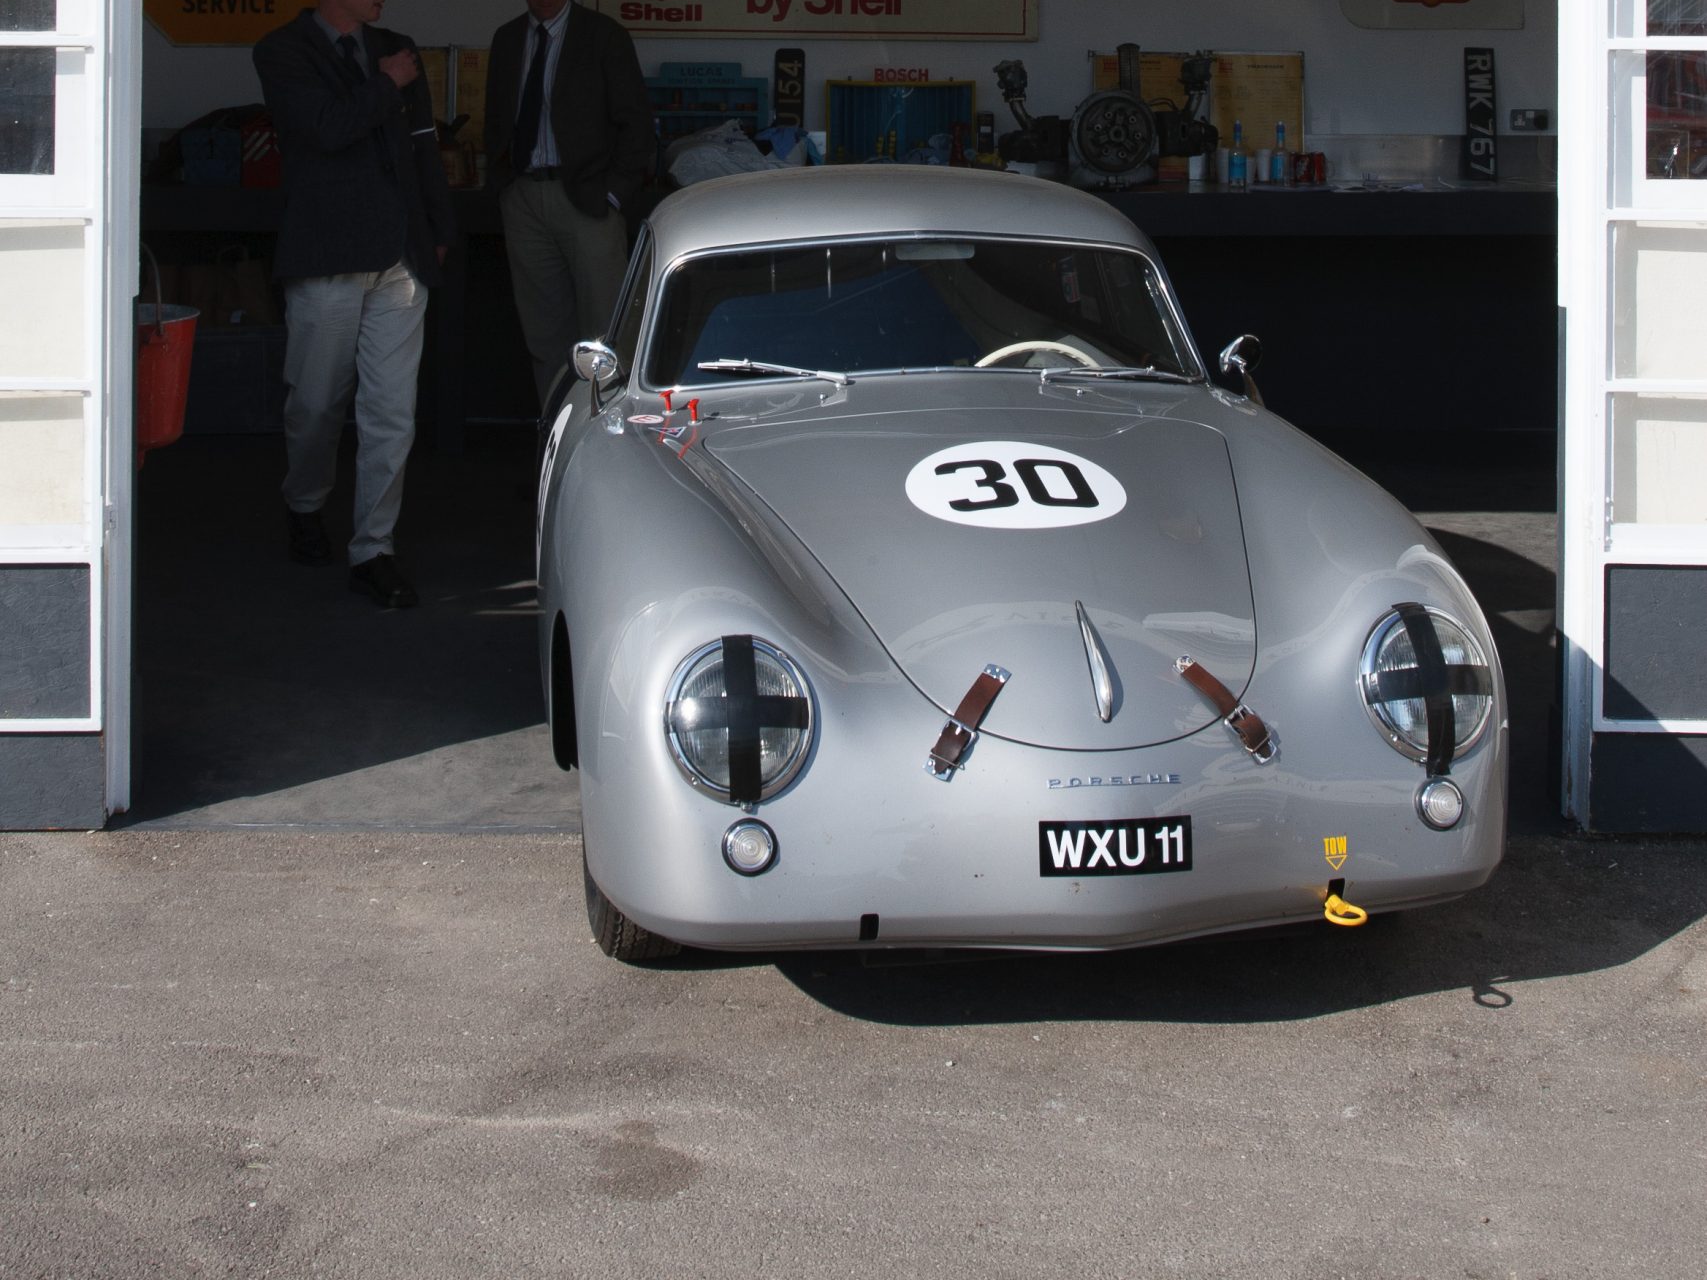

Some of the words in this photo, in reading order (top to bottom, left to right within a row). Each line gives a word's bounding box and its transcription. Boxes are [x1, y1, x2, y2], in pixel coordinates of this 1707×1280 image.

[620, 1, 703, 23] Shell
[680, 66, 723, 77] LUCAS
[778, 60, 802, 104] 154
[873, 68, 929, 82] BOSCH
[1467, 53, 1494, 110] RWK
[1469, 119, 1496, 176] 767
[934, 458, 1100, 512] 30
[1046, 773, 1182, 789] PORSCHE
[1046, 827, 1146, 869] WXU
[1155, 824, 1184, 865] 11
[1323, 834, 1348, 856] TOW
